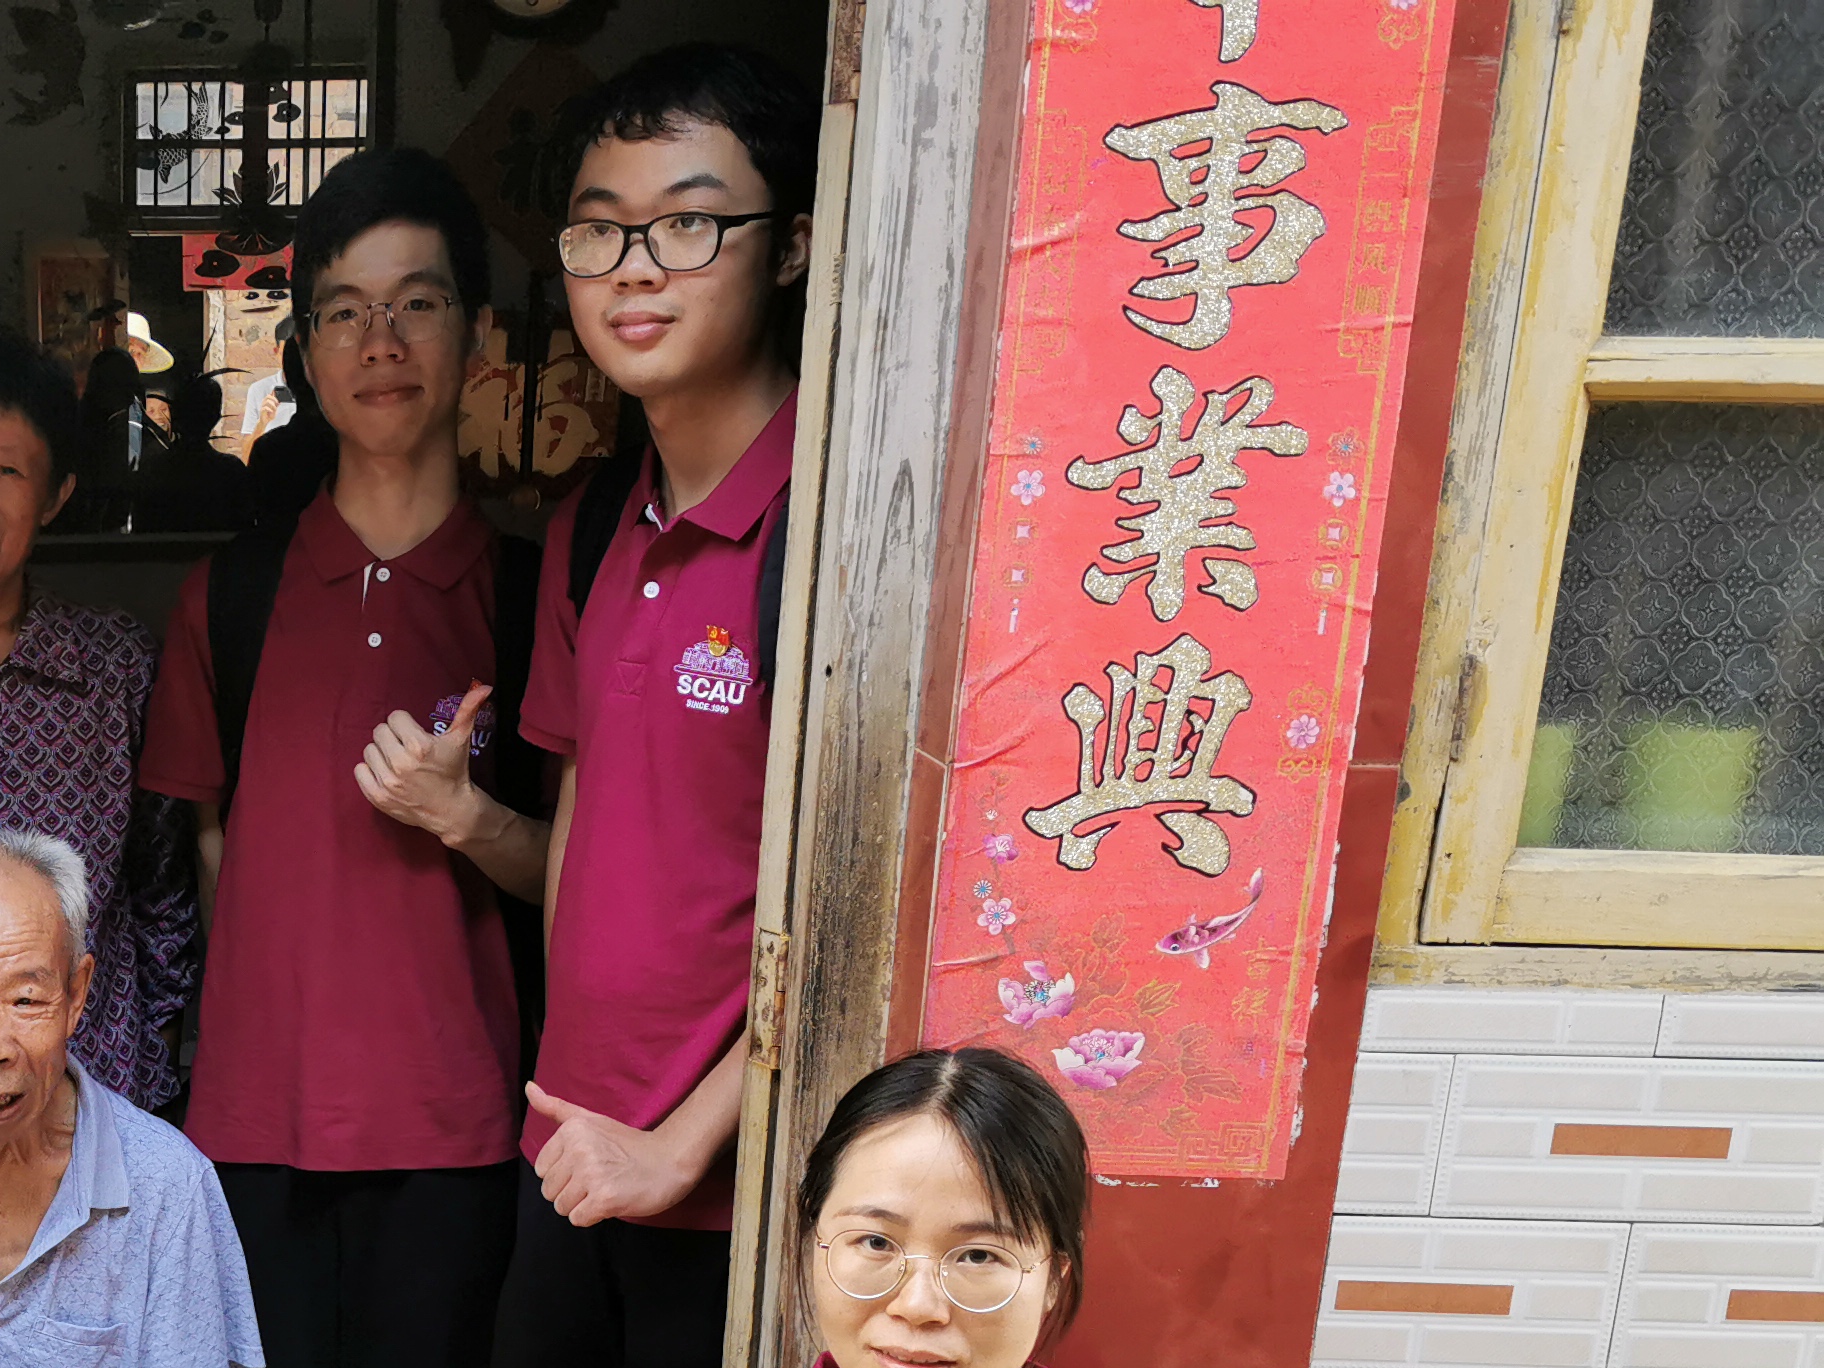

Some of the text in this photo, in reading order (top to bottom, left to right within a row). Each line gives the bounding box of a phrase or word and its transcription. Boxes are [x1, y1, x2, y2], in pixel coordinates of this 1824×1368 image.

[1023, 0, 1349, 875] 事業興
[676, 674, 747, 705] SCAU
[686, 699, 730, 714] SINCE 1909
[433, 721, 492, 748] SU
